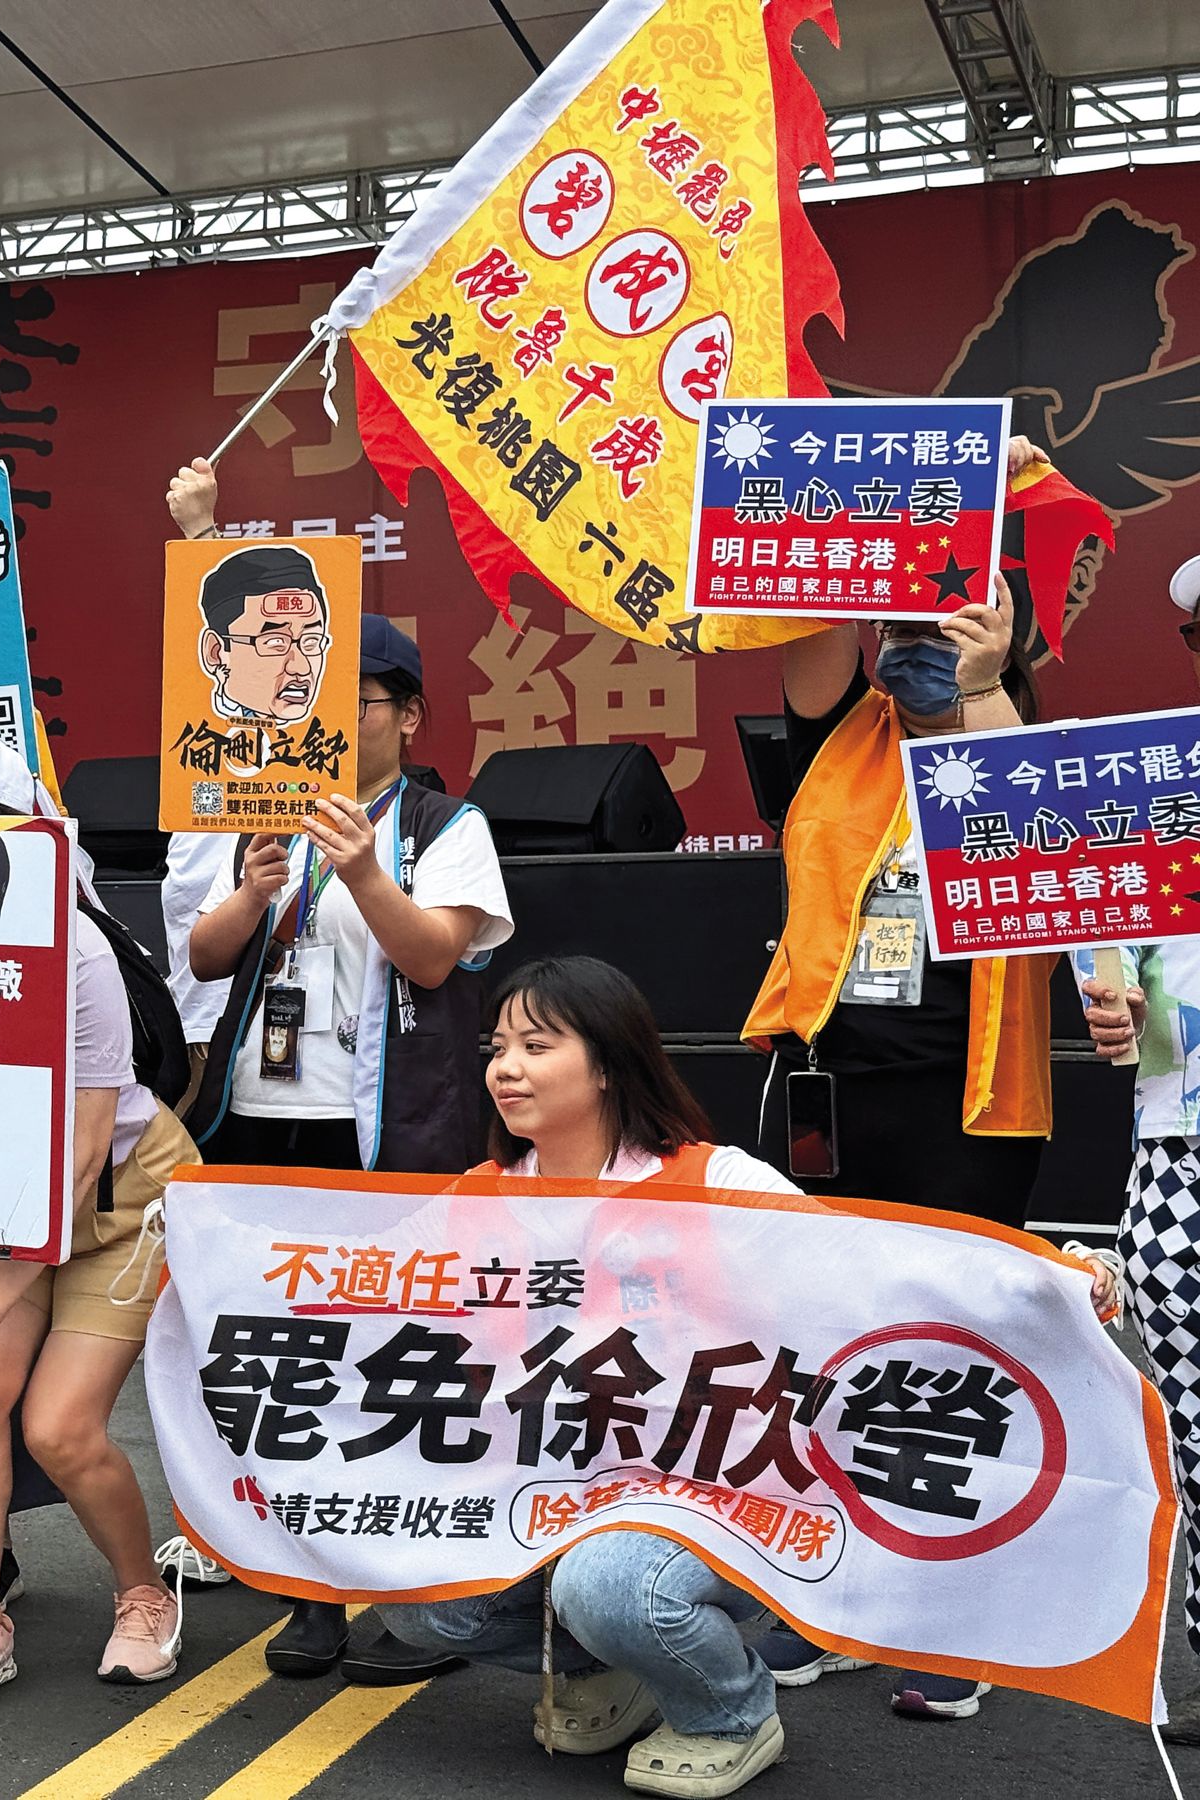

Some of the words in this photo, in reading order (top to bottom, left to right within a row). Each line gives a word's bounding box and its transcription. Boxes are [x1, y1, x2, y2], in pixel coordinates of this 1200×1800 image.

[617, 86, 751, 260] 中壢罷免
[393, 313, 583, 522] 光復桃園
[789, 429, 992, 466] 今日不罷免
[734, 476, 962, 526] 黑心立委
[710, 536, 897, 570] 明日是香港
[276, 595, 303, 611] 罷免
[709, 575, 892, 595] 自己的國家自己救
[755, 594, 799, 602] FREEDOM!
[227, 781, 276, 795] 歡迎加入
[226, 799, 320, 816] 雙和罷免社群
[961, 791, 1200, 864] 黑心立委
[944, 861, 1150, 911] 明日是香港
[952, 903, 1152, 937] 自己的國家自己救
[953, 936, 981, 945] FIGHT
[983, 934, 1003, 942] FOR
[1004, 930, 1053, 941] FREEDOM!
[1056, 927, 1088, 937] STAND
[1116, 922, 1153, 932] TAIWAN
[262, 1241, 586, 1312] 不適任立委
[200, 1313, 1018, 1521] 罷免徐欣瑩
[269, 1492, 497, 1539] 請支援收瑩
